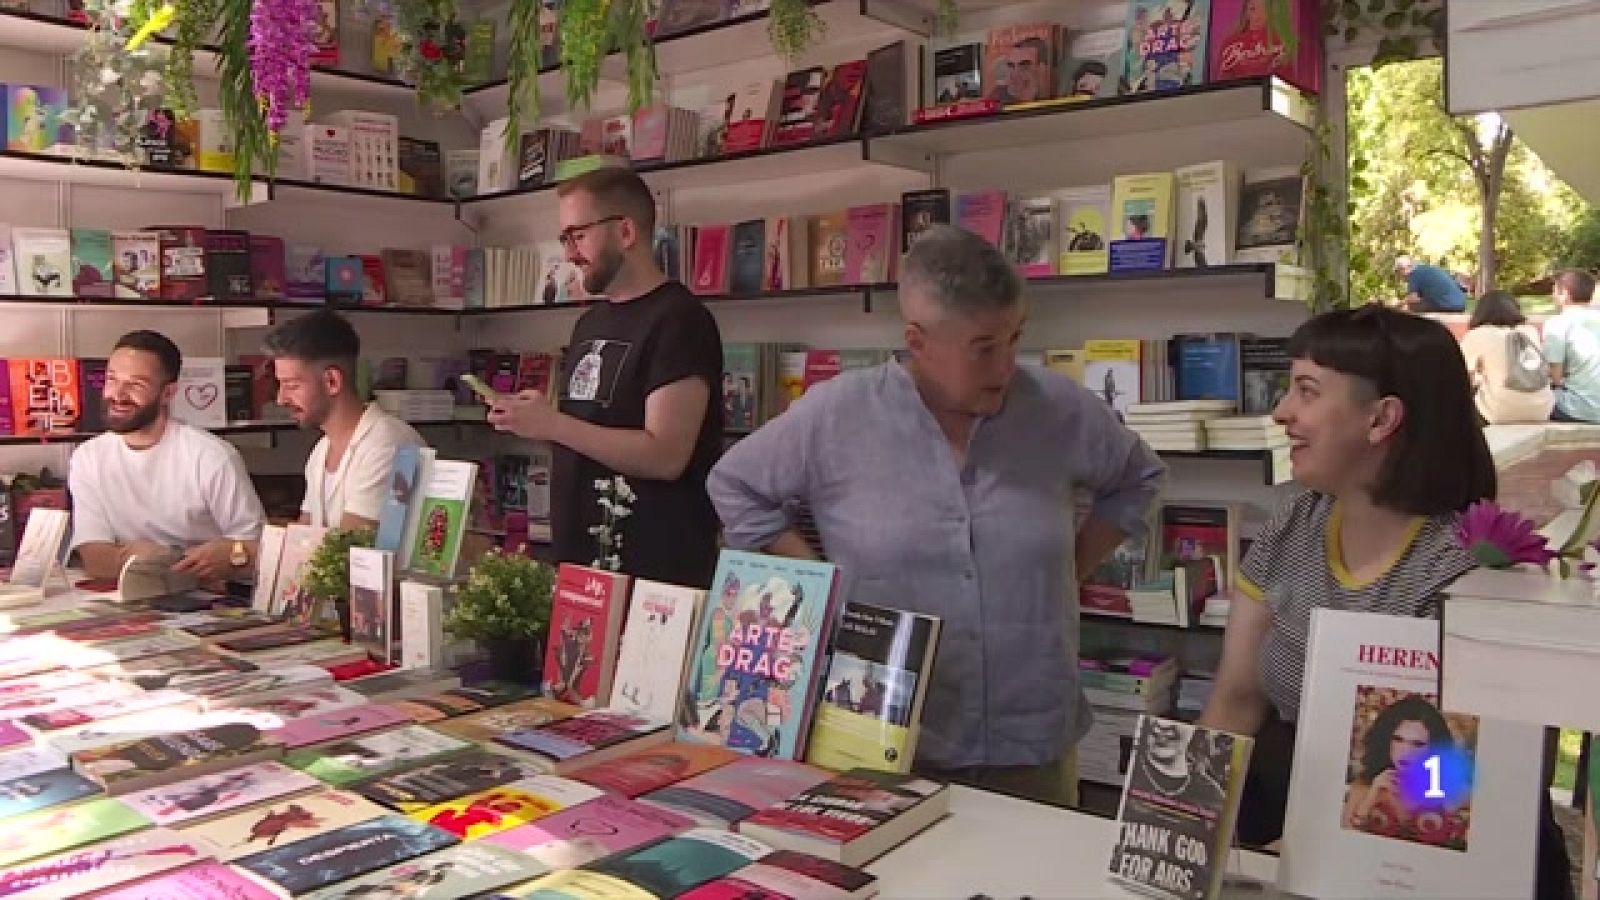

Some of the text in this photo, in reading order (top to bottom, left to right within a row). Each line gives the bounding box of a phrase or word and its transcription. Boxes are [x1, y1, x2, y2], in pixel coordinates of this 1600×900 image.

[729, 621, 794, 653] ARTE
[717, 644, 792, 680] DRAG
[1175, 834, 1207, 866] GOD
[1121, 854, 1194, 893] FOR AIDS
